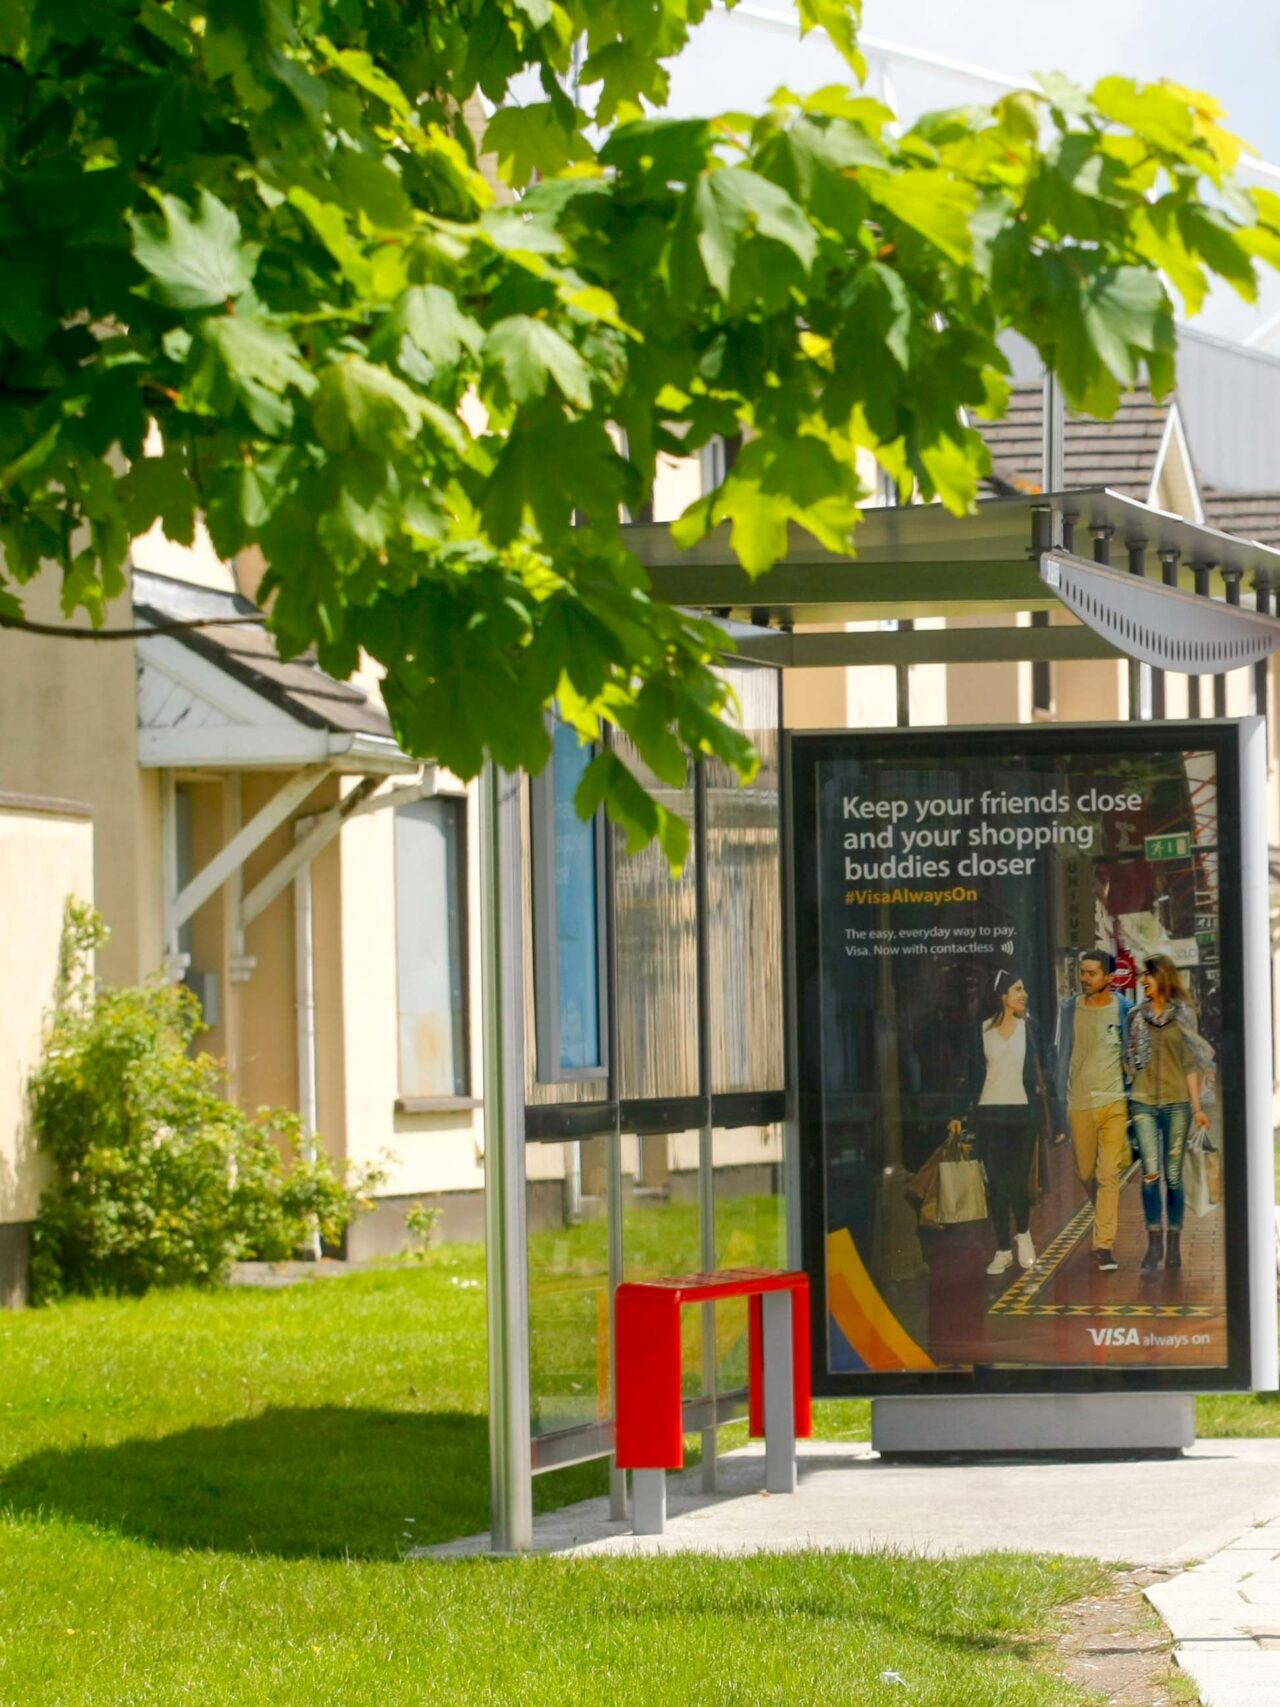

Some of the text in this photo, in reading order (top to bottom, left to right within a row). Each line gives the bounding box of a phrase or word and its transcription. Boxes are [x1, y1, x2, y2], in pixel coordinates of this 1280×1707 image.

[842, 789, 1142, 823] Keep your friends close
[843, 821, 1094, 854] and your shopping
[845, 853, 1035, 880] buddies closer
[845, 886, 977, 906] #VisaAlwaysOn
[845, 926, 1017, 941] The easy, everyday way to pay.
[845, 942, 994, 957] Visa. Now with contactless
[1086, 1328, 1211, 1348] VISA always on
